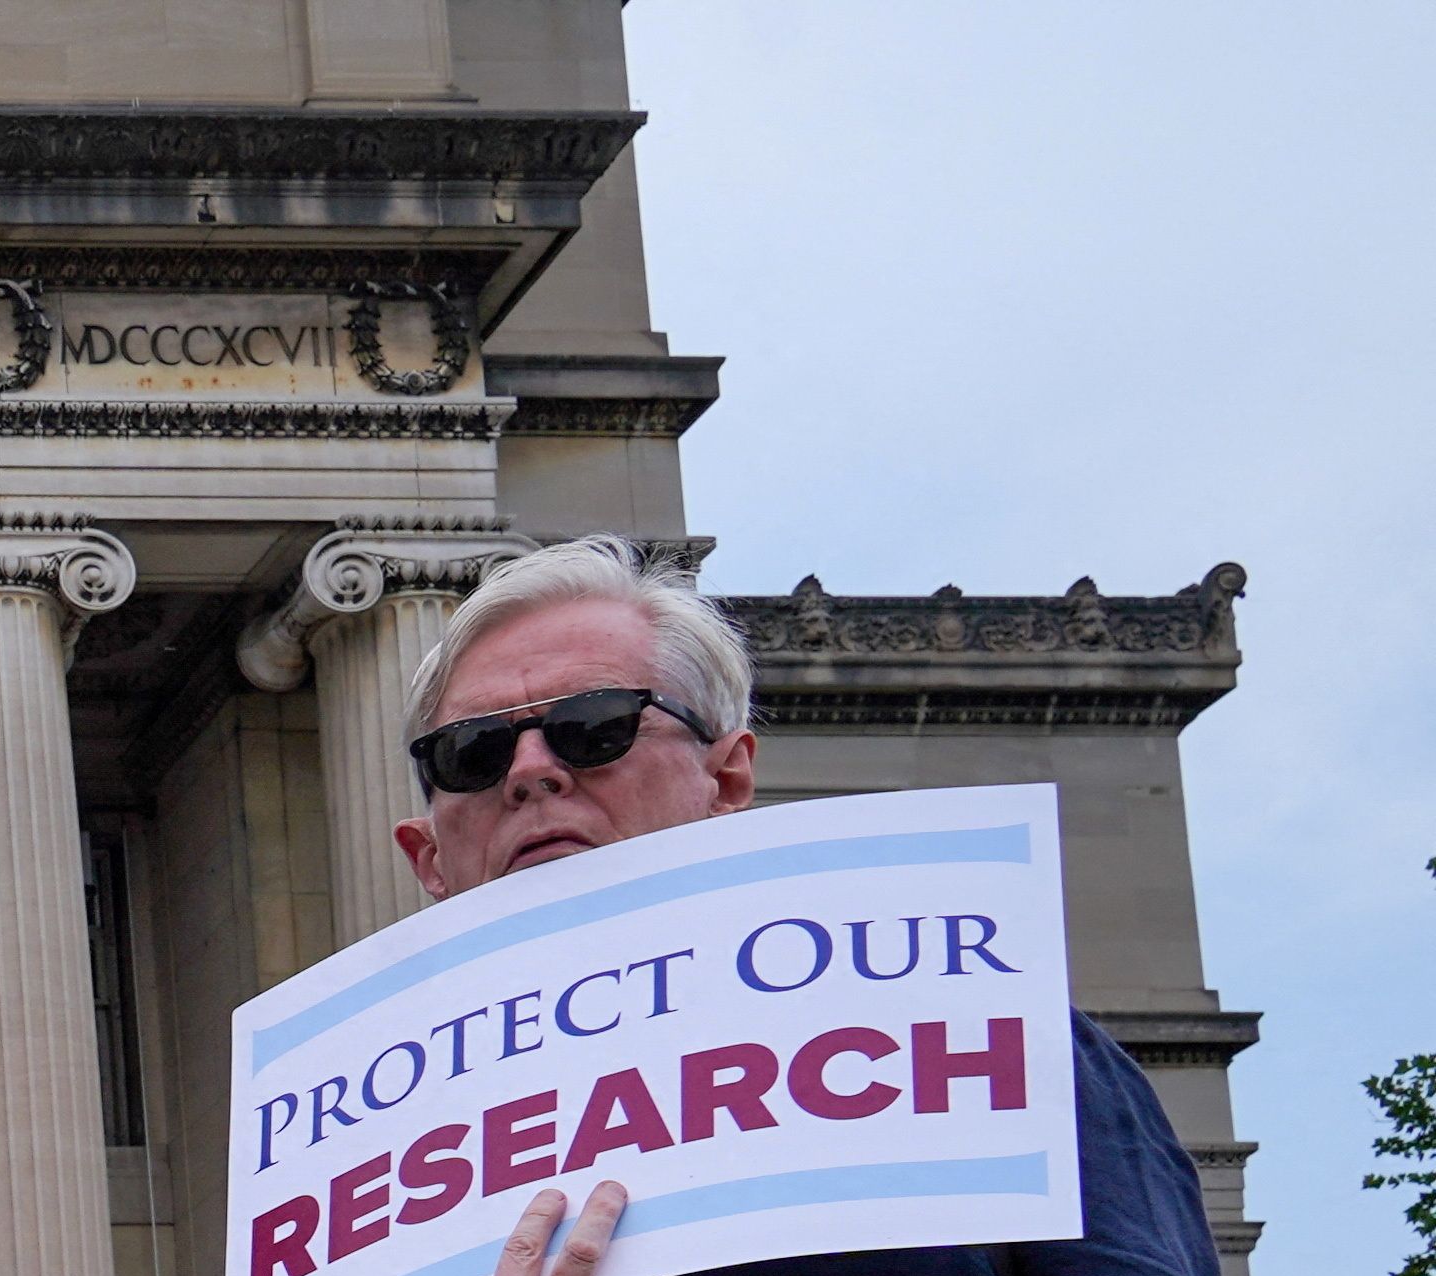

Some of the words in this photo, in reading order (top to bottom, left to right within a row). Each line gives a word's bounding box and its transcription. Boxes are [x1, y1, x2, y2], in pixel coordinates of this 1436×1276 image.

[60, 324, 338, 368] MDCCCXCVII
[253, 947, 694, 1177] PROTECT
[735, 913, 1023, 994] OUR
